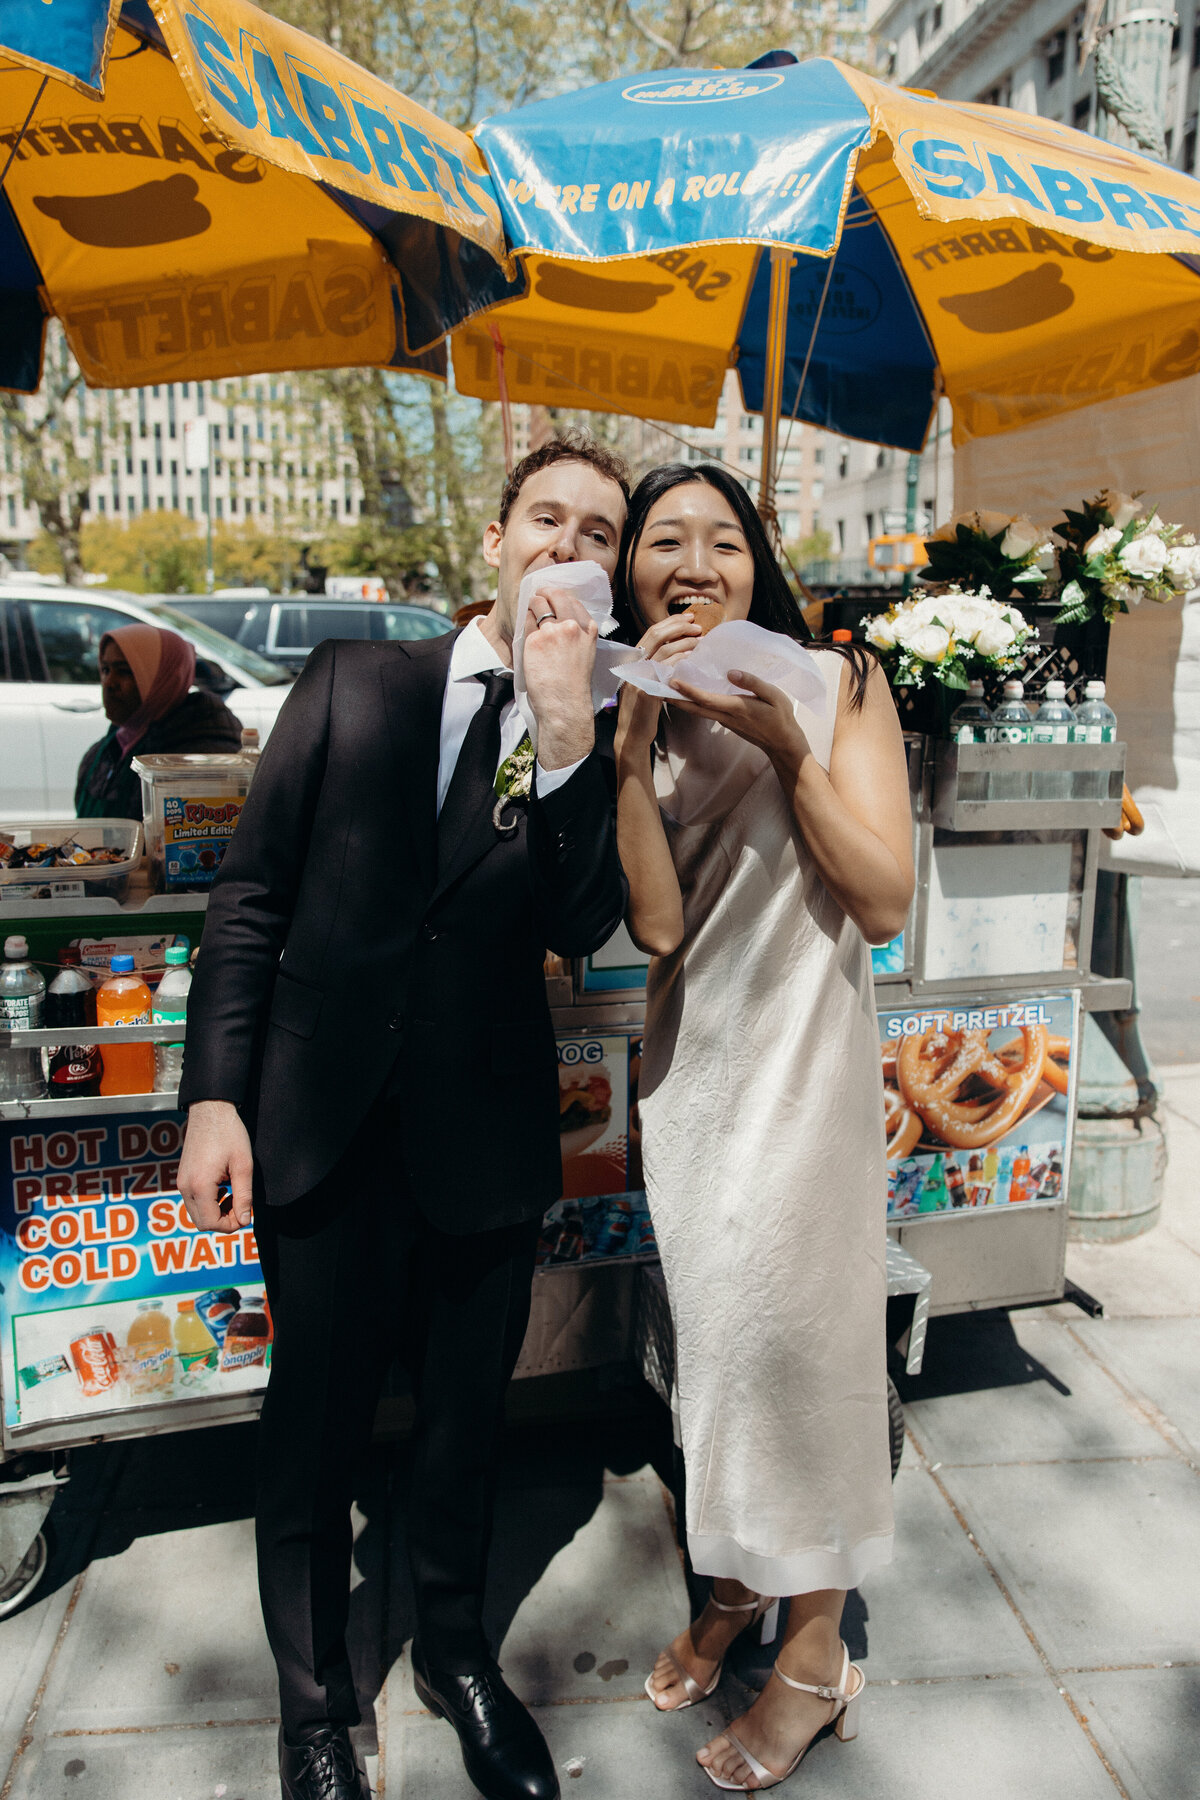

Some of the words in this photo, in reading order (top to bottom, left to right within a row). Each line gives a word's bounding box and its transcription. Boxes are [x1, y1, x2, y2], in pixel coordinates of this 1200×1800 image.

[607, 180, 650, 211] ON
[653, 177, 676, 206] A
[184, 803, 243, 824] RingP
[174, 827, 209, 839] Limited
[886, 1013, 948, 1038] SOFT
[951, 1004, 1053, 1033] PRETZEL
[11, 1128, 107, 1173] HOT
[118, 1119, 190, 1161] DO
[16, 1204, 139, 1252] COLD
[18, 1244, 141, 1293] COLD
[222, 1345, 265, 1368] Snapple
